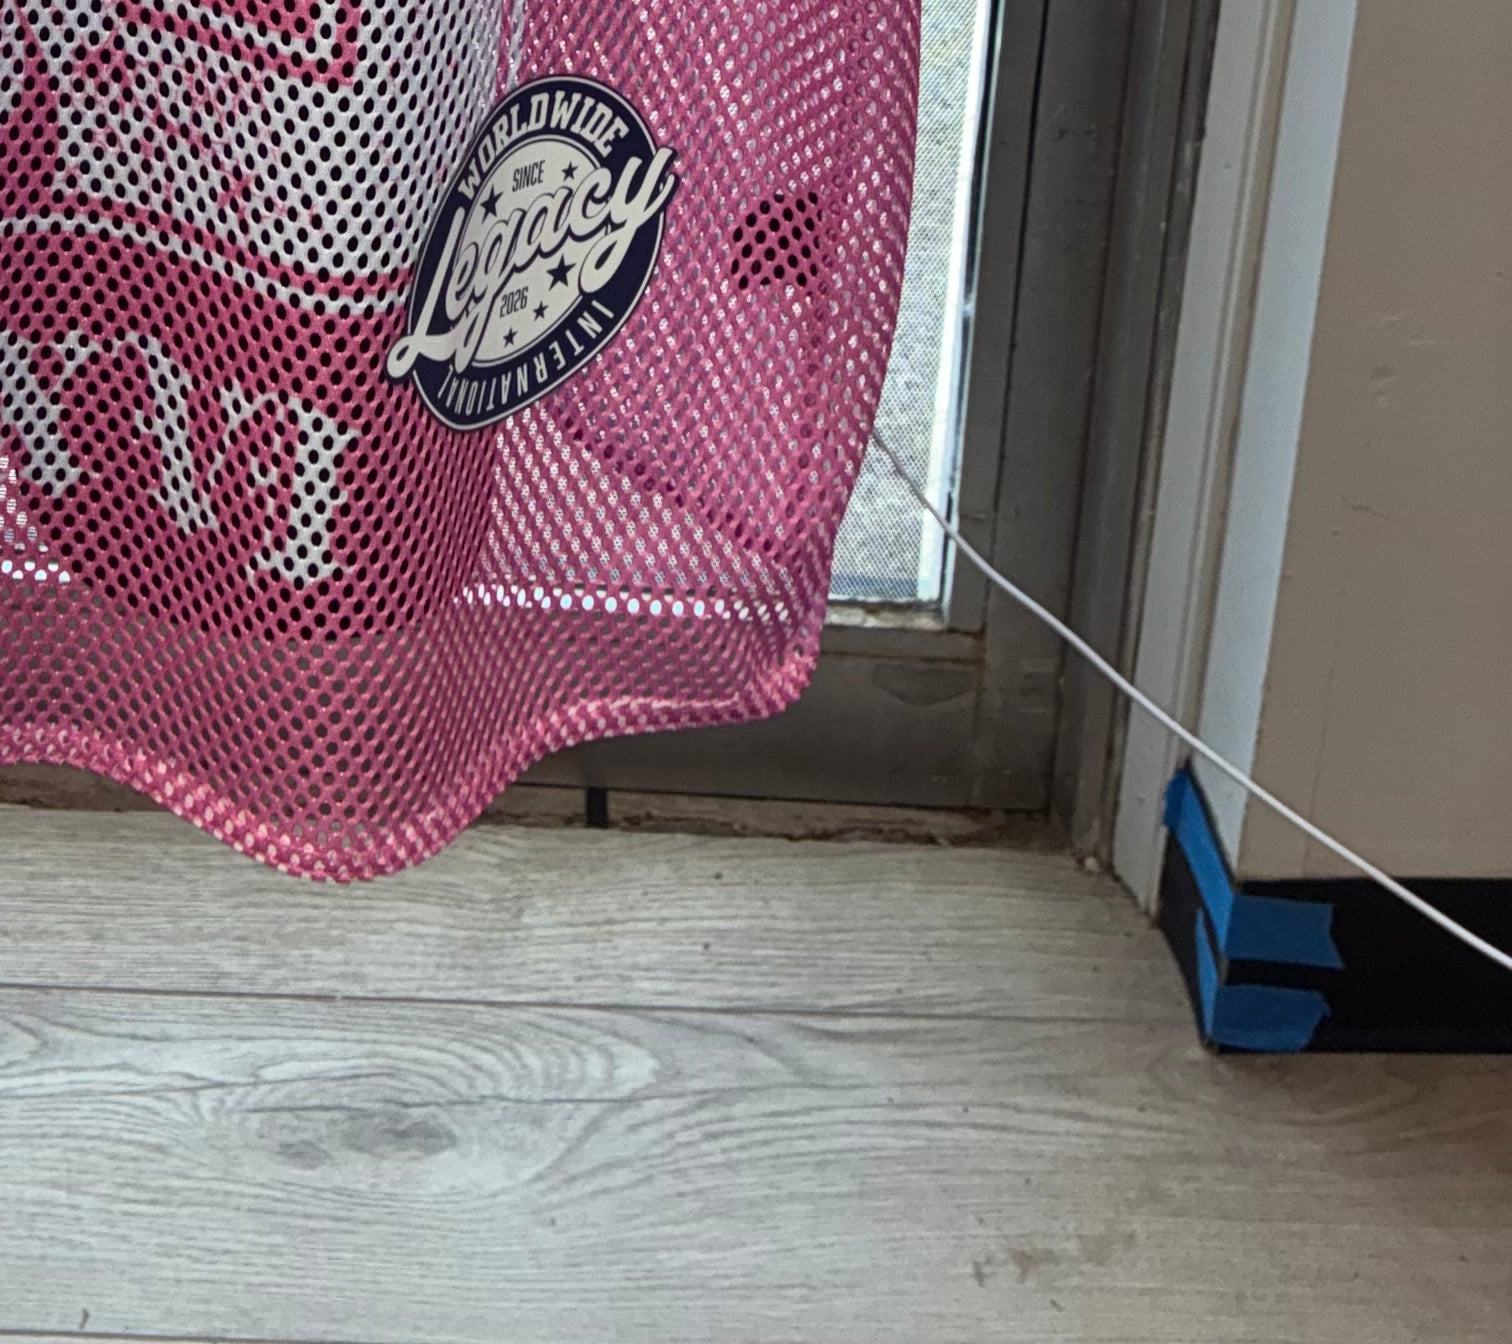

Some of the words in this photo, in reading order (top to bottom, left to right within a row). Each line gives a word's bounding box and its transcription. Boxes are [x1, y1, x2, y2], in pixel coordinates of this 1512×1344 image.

[458, 90, 629, 200] WORLDWIDE
[512, 159, 544, 193] SINCE
[387, 147, 676, 378] Legacy
[500, 285, 528, 318] 2026
[438, 299, 614, 416] INTERNATIONAL
